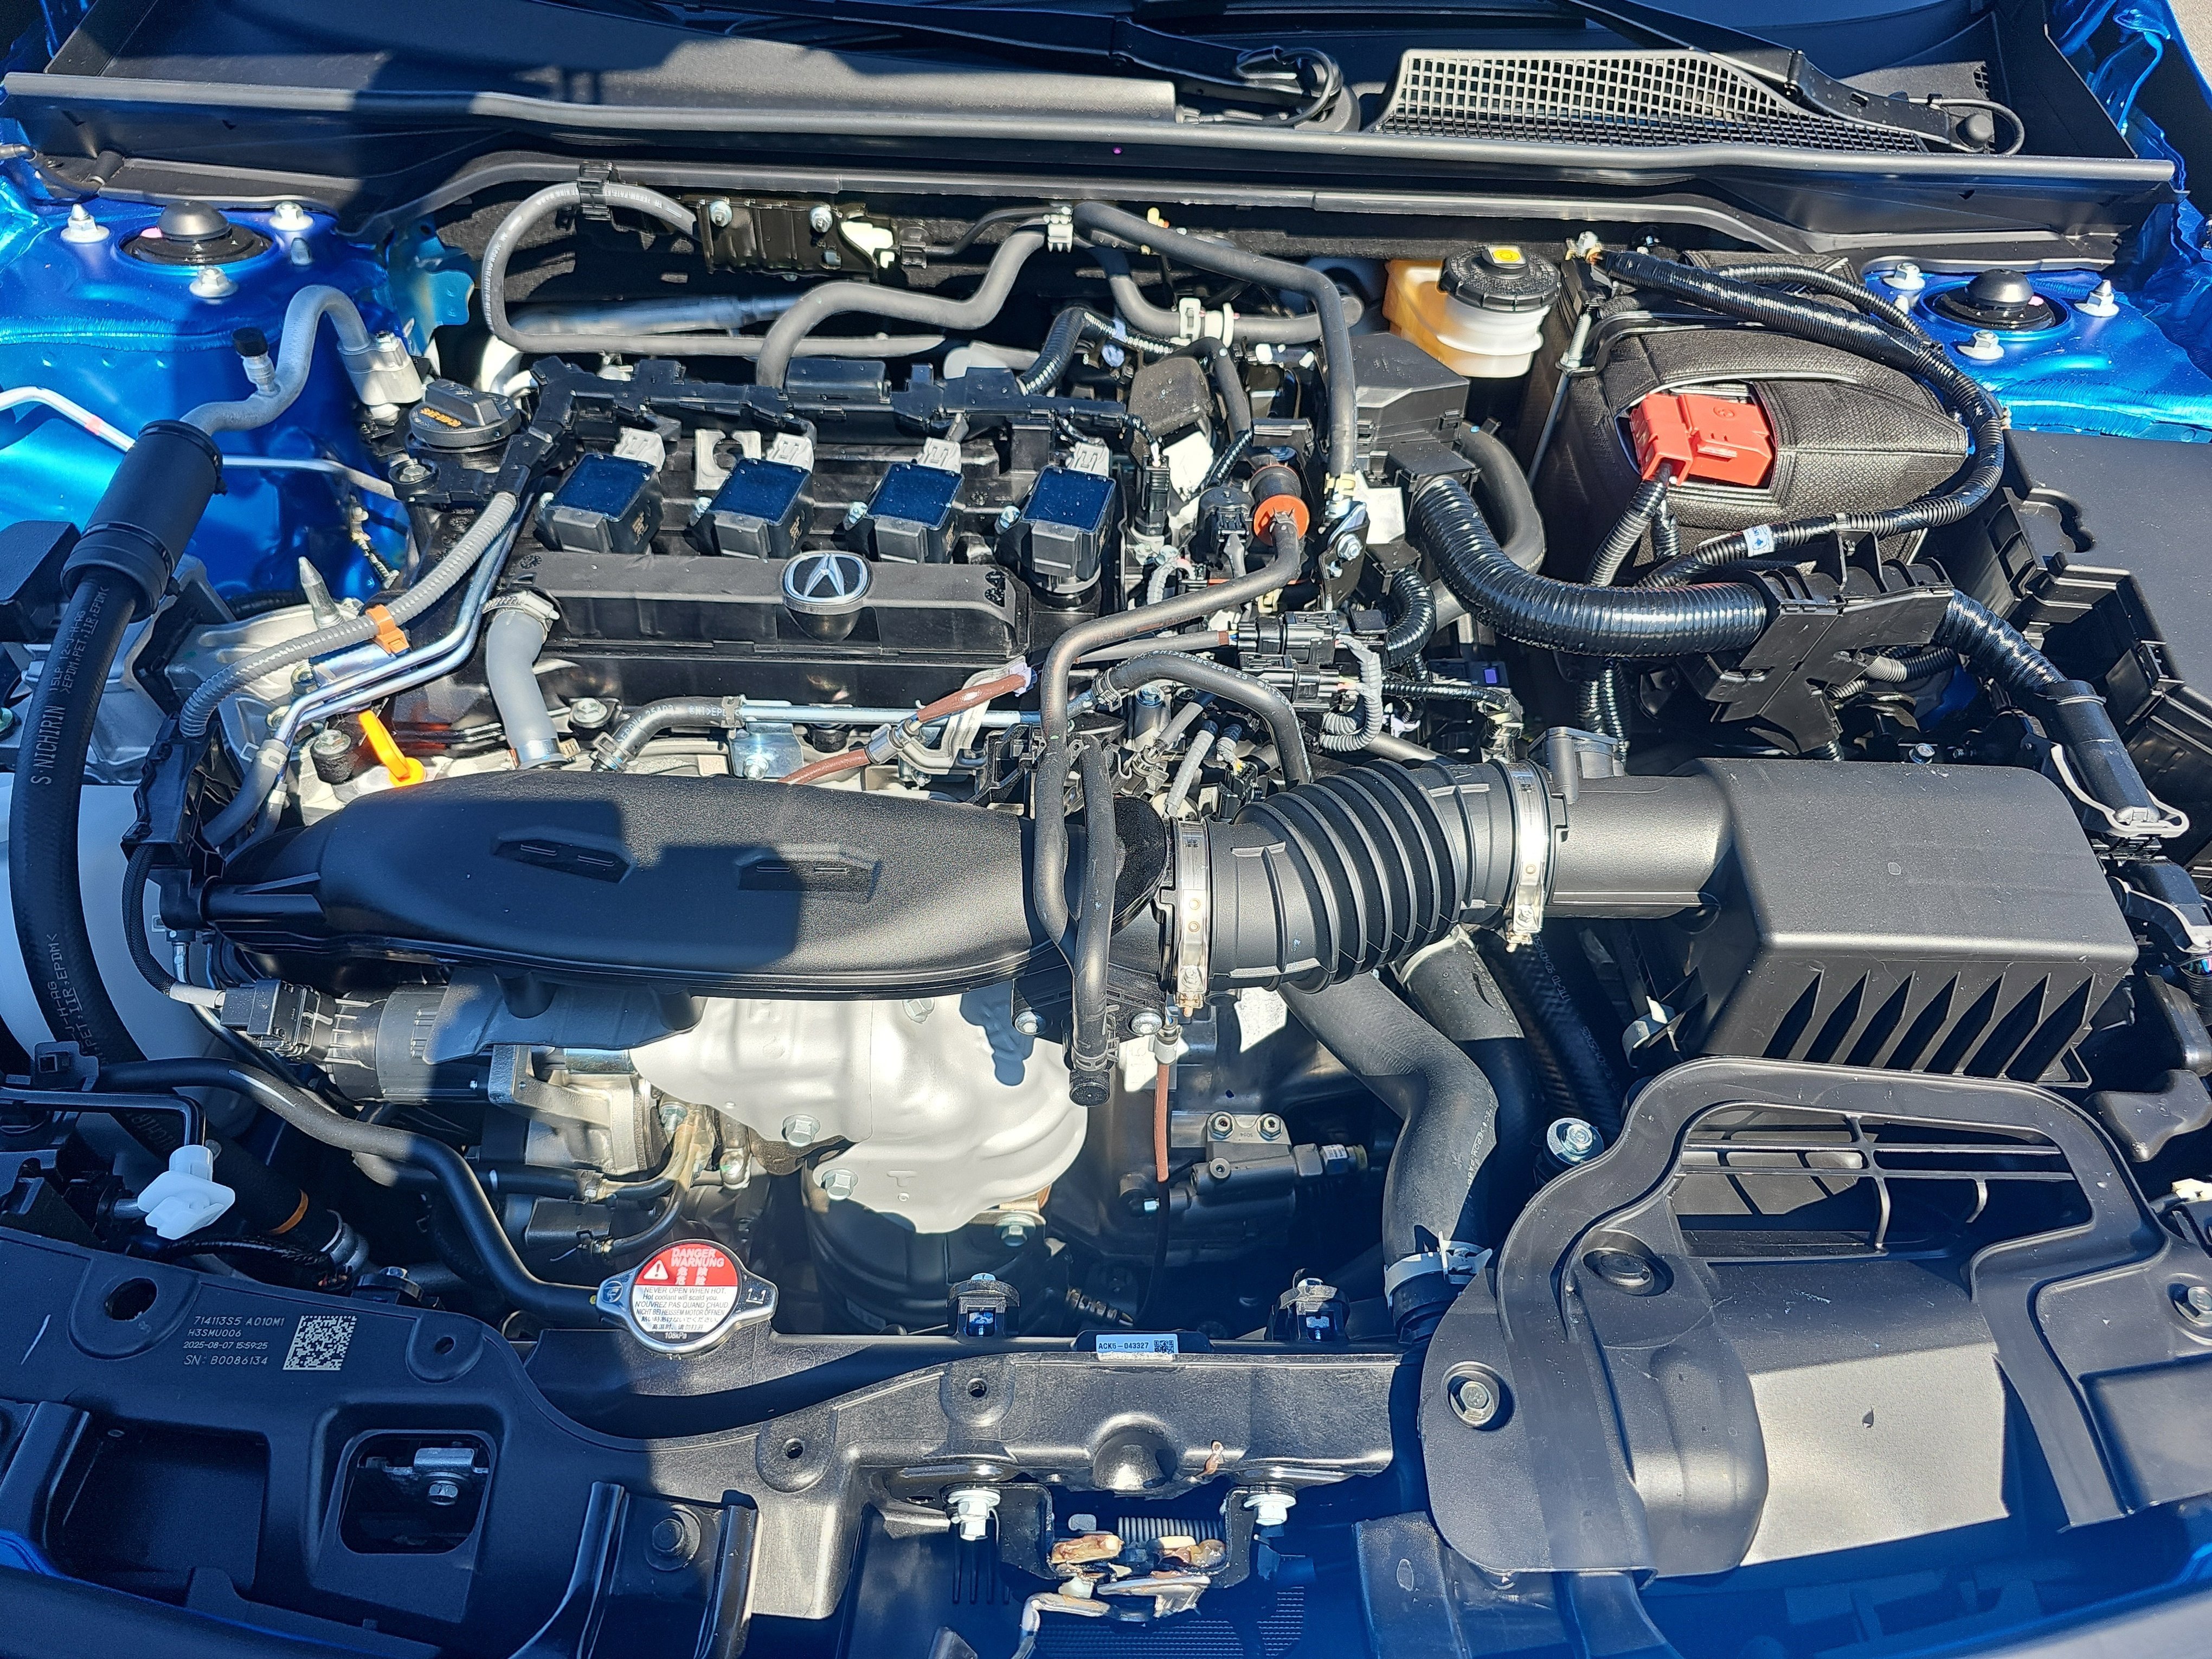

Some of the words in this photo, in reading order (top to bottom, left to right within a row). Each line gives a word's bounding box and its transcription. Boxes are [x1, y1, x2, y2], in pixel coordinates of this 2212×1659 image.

[1211, 662, 1229, 673] 254
[672, 1249, 716, 1258] DANGER
[671, 1257, 724, 1267] WARNUNG
[245, 1317, 285, 1327] A010M1
[187, 1328, 242, 1338] H3SMU006
[183, 1341, 234, 1349] 2025-08-07
[210, 1355, 268, 1366] B0086134
